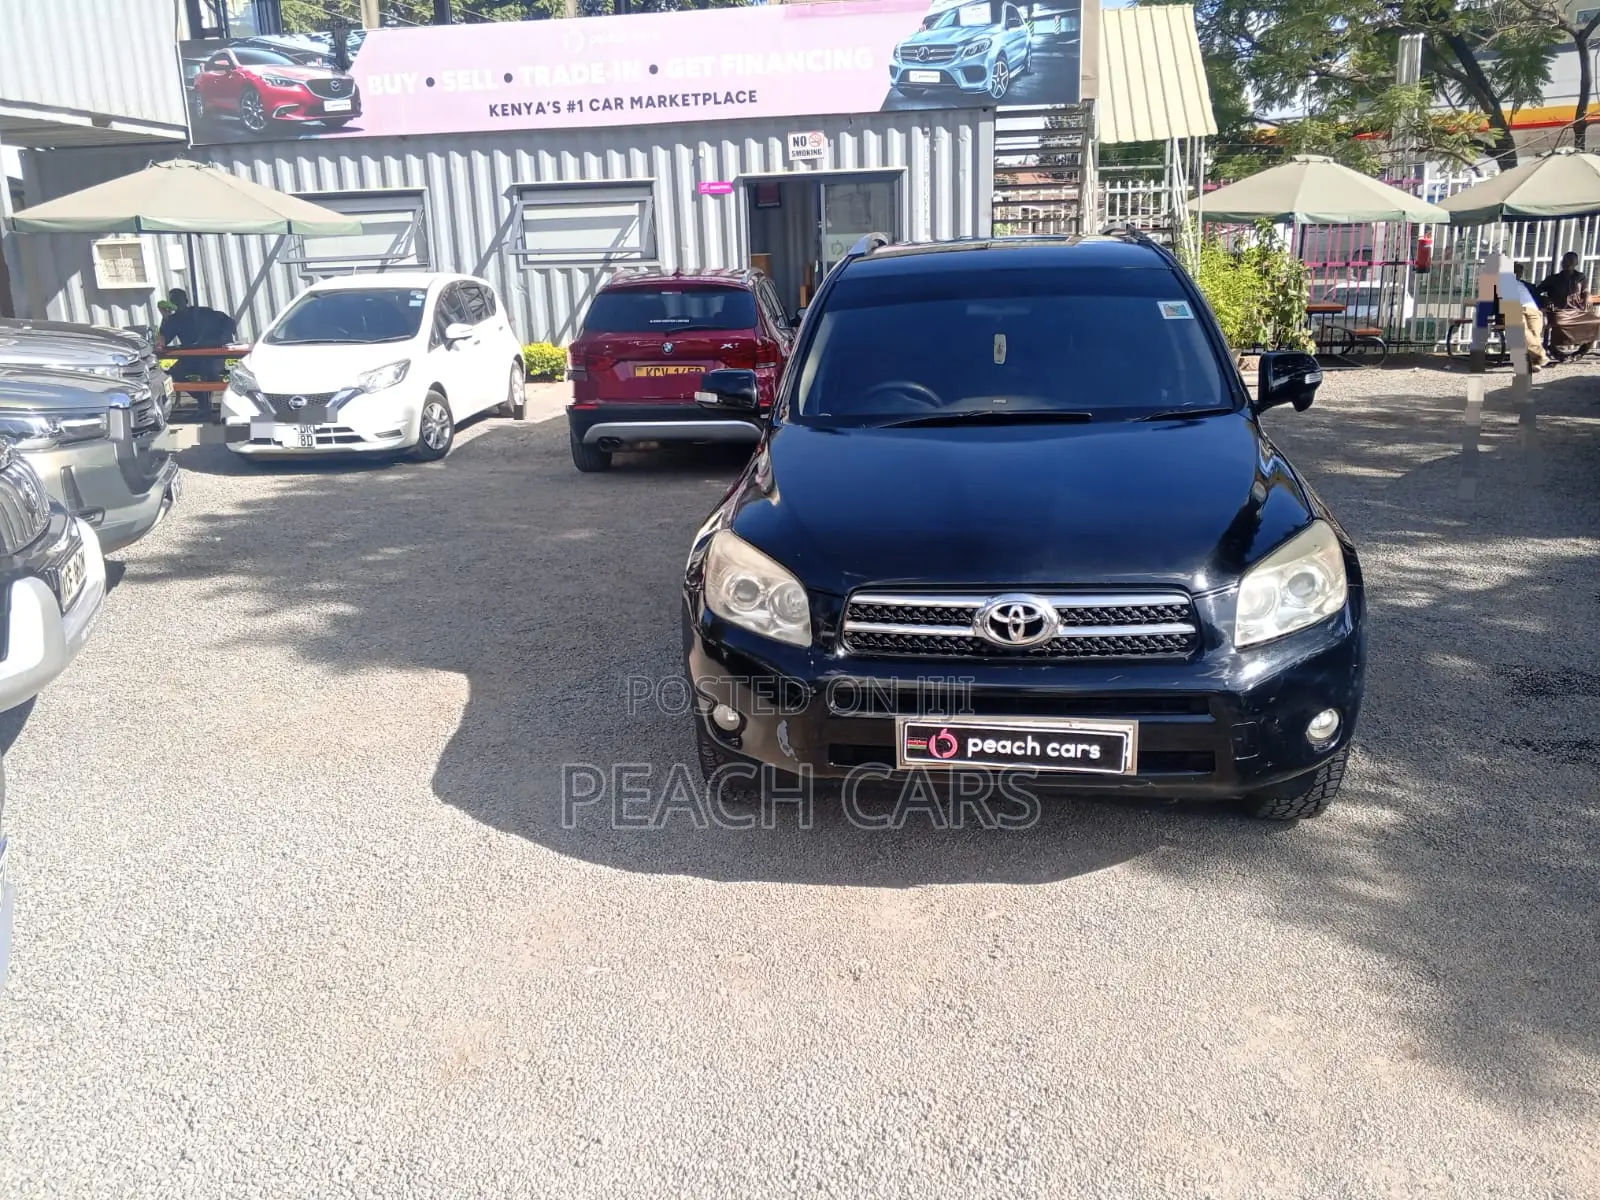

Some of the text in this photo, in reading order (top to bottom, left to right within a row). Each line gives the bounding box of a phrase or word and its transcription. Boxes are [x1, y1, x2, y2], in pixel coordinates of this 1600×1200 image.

[366, 46, 876, 96] BUY SELL TRADE-IN GET FINANCING
[488, 90, 758, 117] KENYA'S #1 CAR MARKETPLACE
[791, 148, 822, 158] SMOKING
[792, 135, 807, 147] NO
[967, 735, 1101, 760] peach cars
